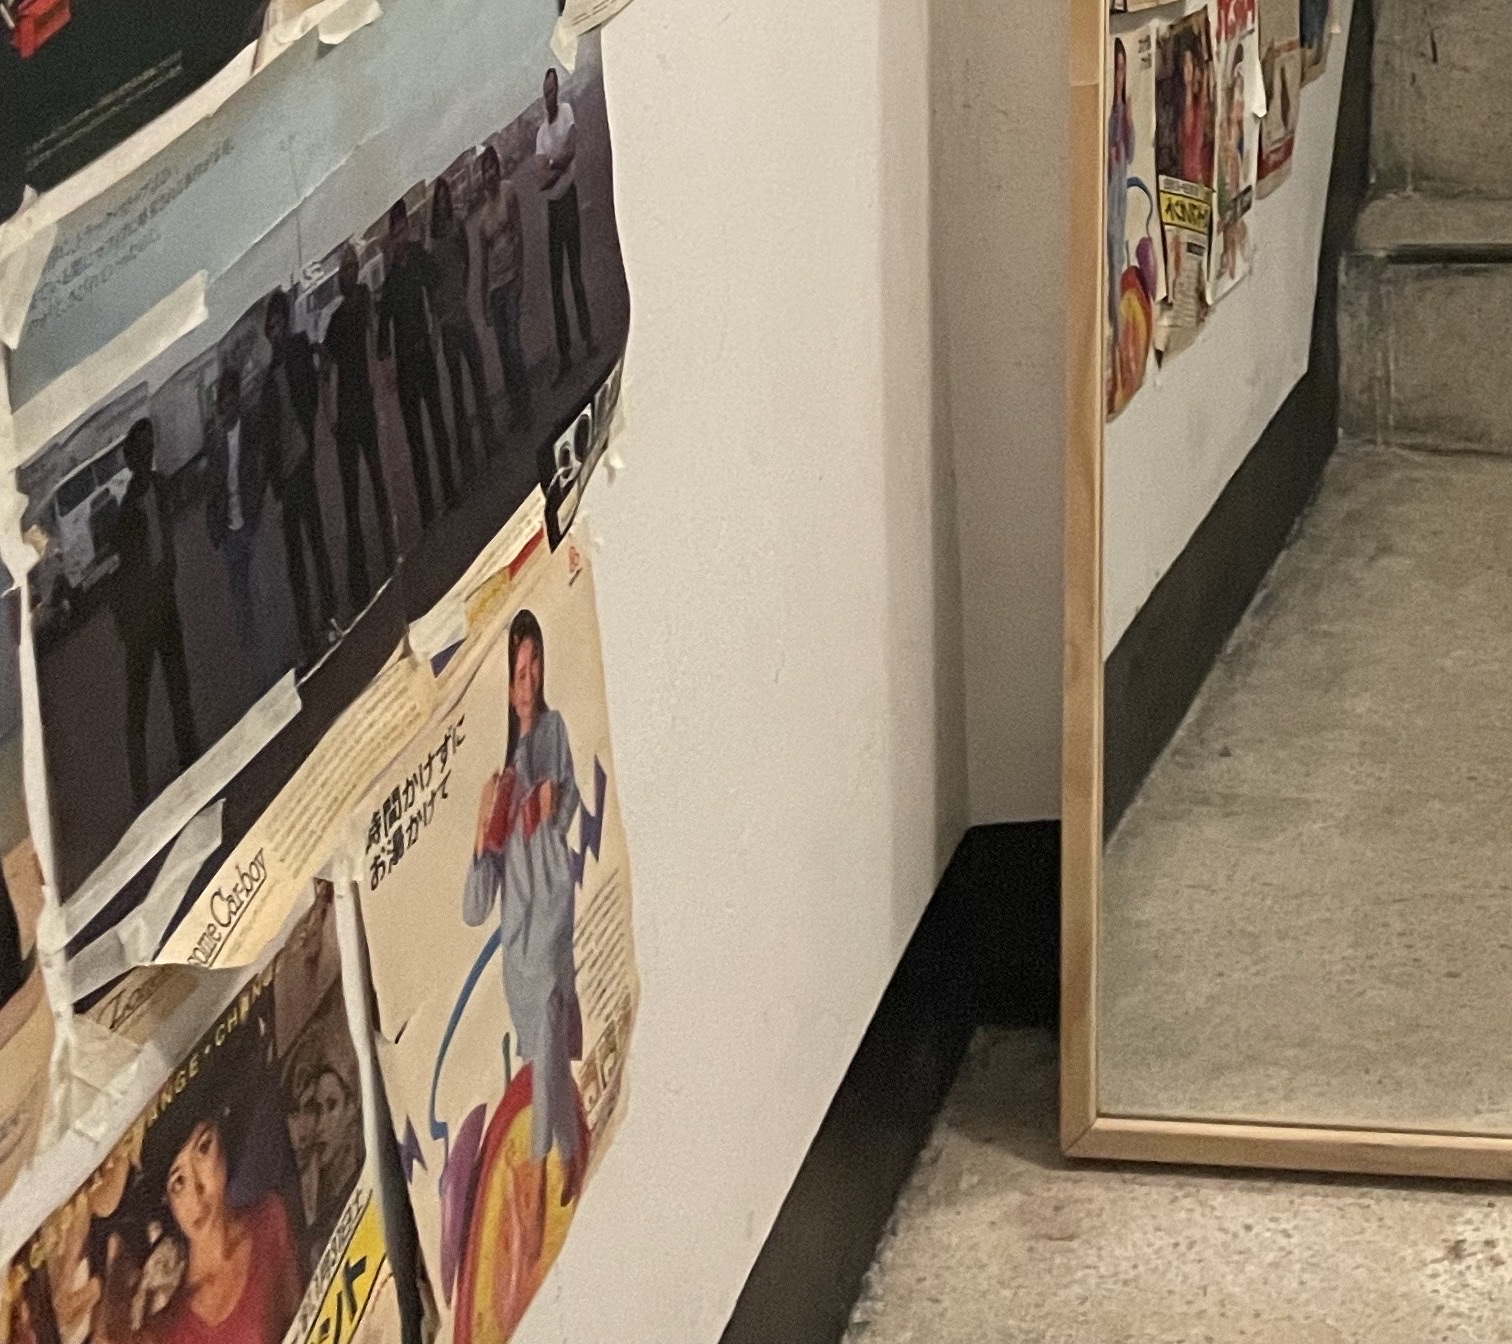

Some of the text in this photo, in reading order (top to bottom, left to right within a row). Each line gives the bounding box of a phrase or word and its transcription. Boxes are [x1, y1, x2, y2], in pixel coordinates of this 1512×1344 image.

[366, 714, 466, 855] 時間かけずに
[370, 769, 452, 891] お湯かけて
